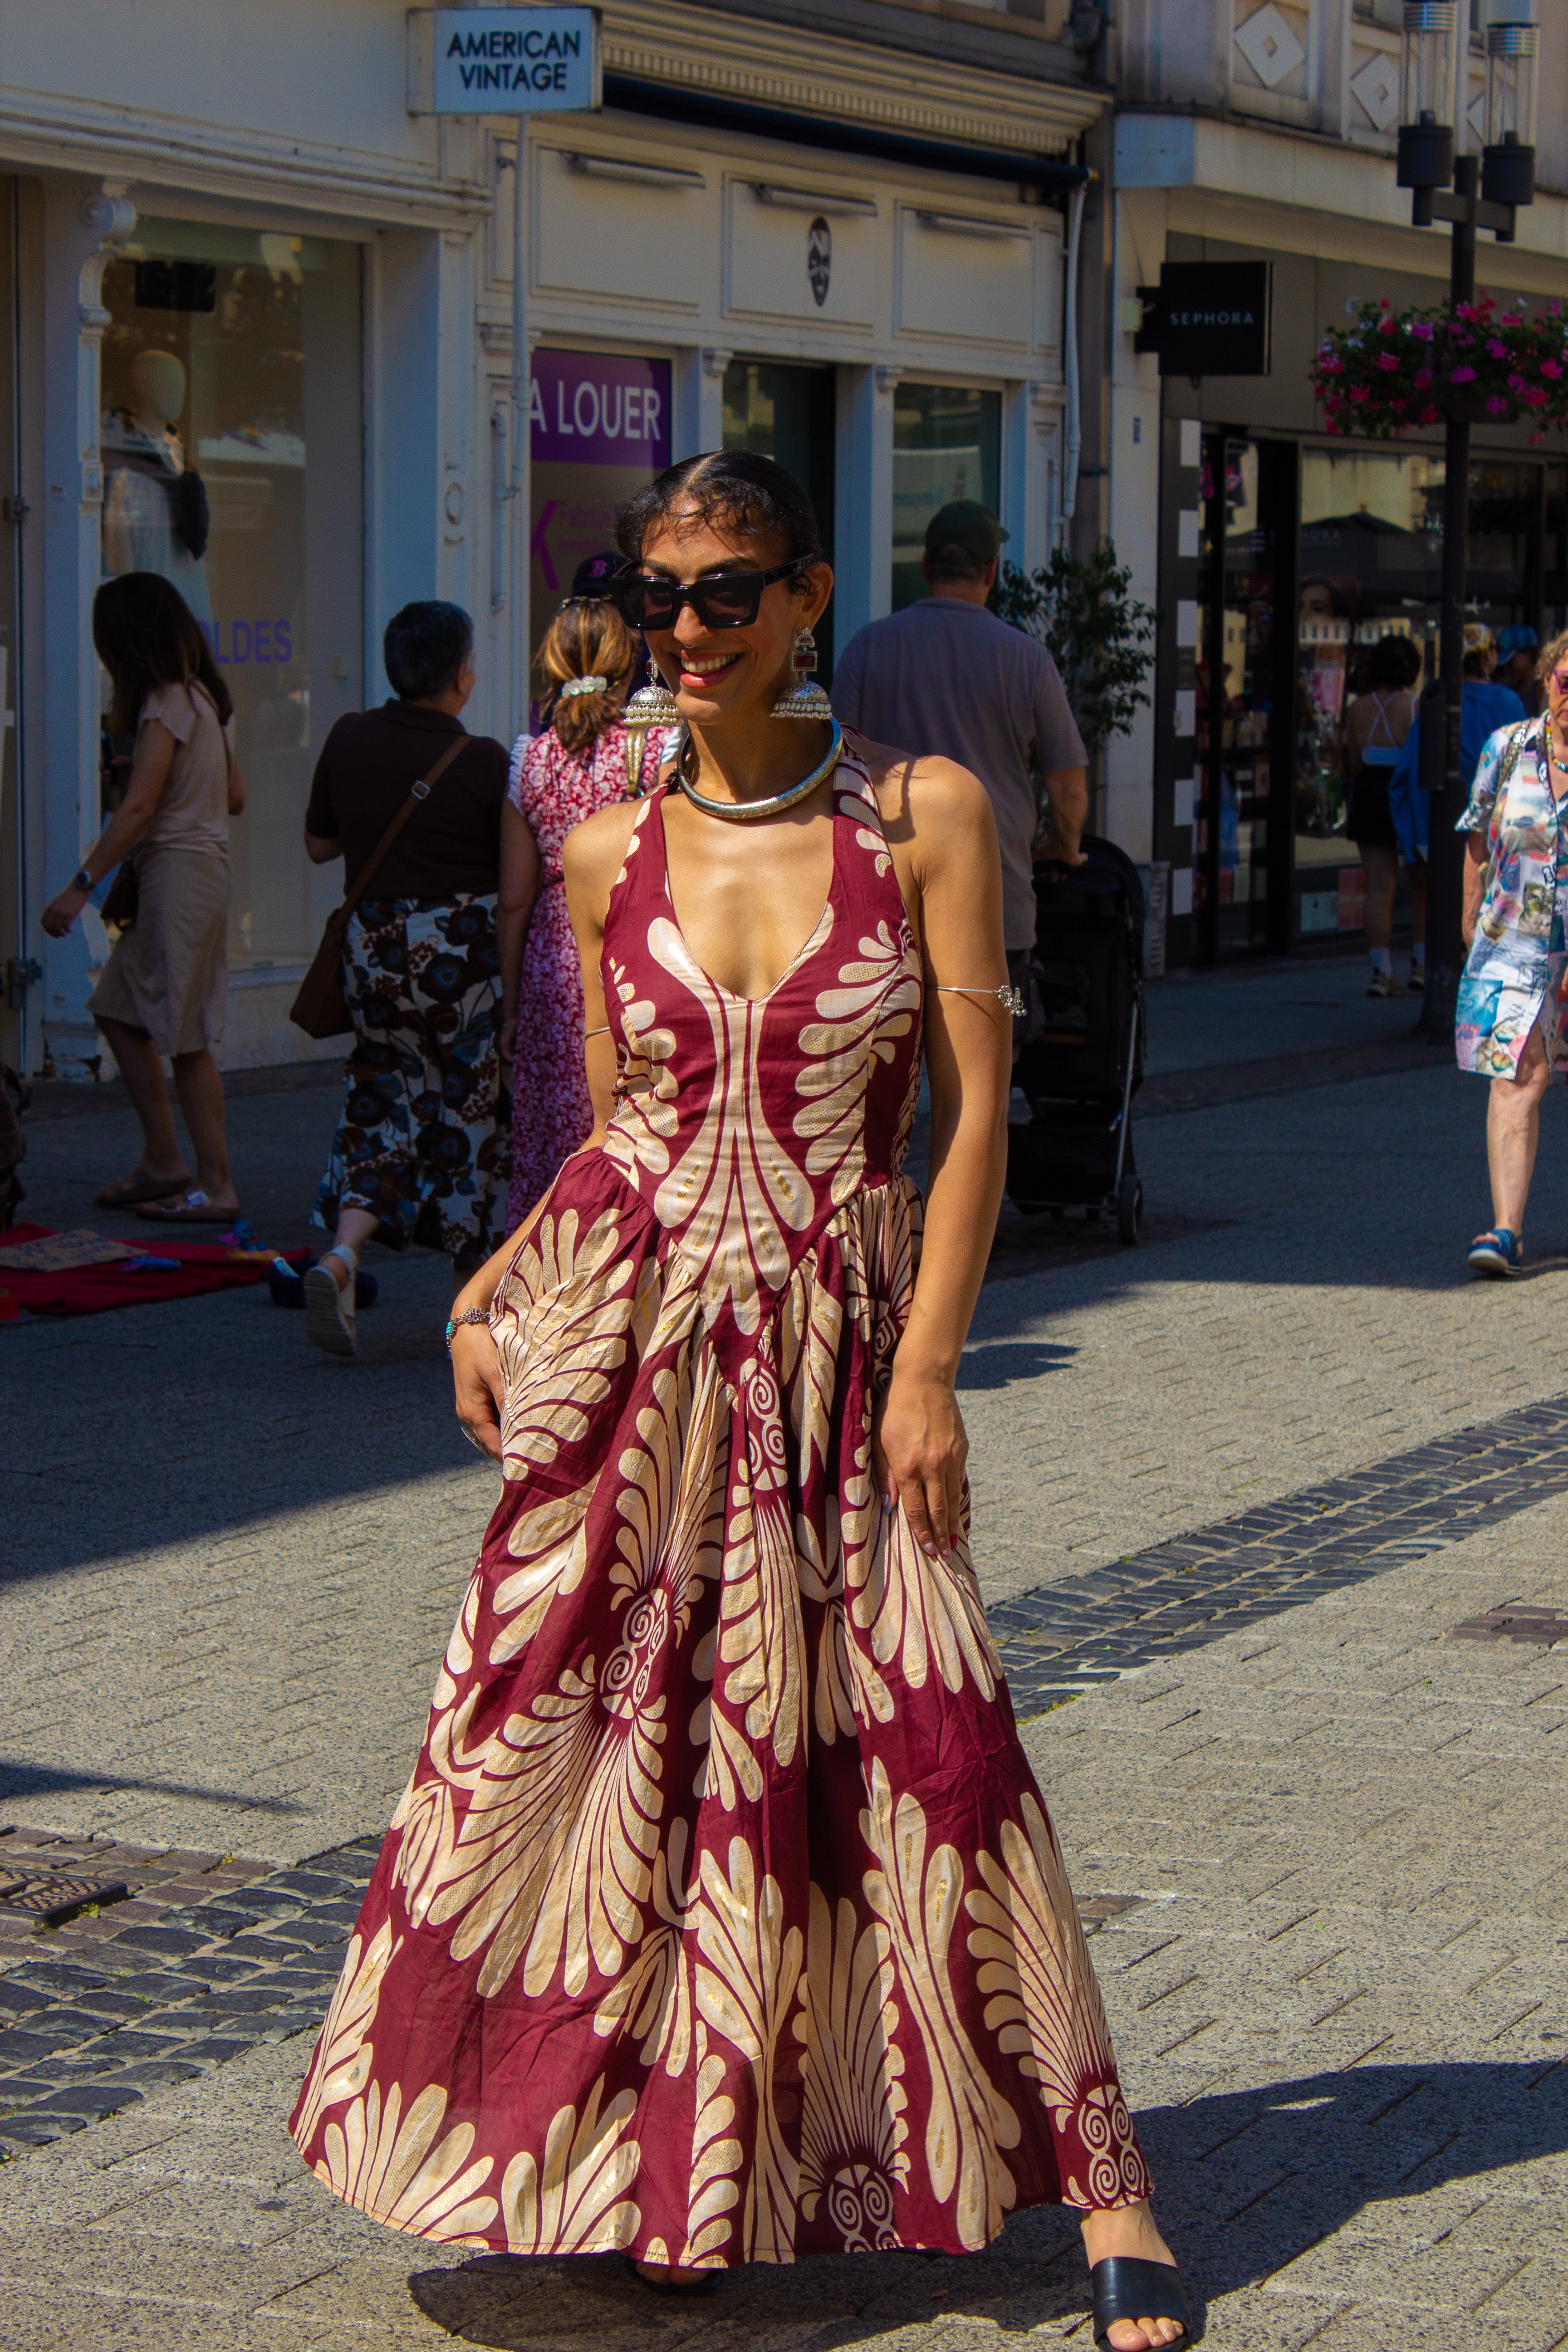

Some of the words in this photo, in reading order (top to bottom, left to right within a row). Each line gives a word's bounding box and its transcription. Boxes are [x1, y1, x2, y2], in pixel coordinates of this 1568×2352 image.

[446, 30, 581, 58] AMERICAN
[459, 63, 567, 90] VINTAGE
[1169, 311, 1254, 326] SEPHORA
[557, 379, 662, 441] LOUER
[588, 559, 608, 578] B
[197, 618, 293, 664] LDES
